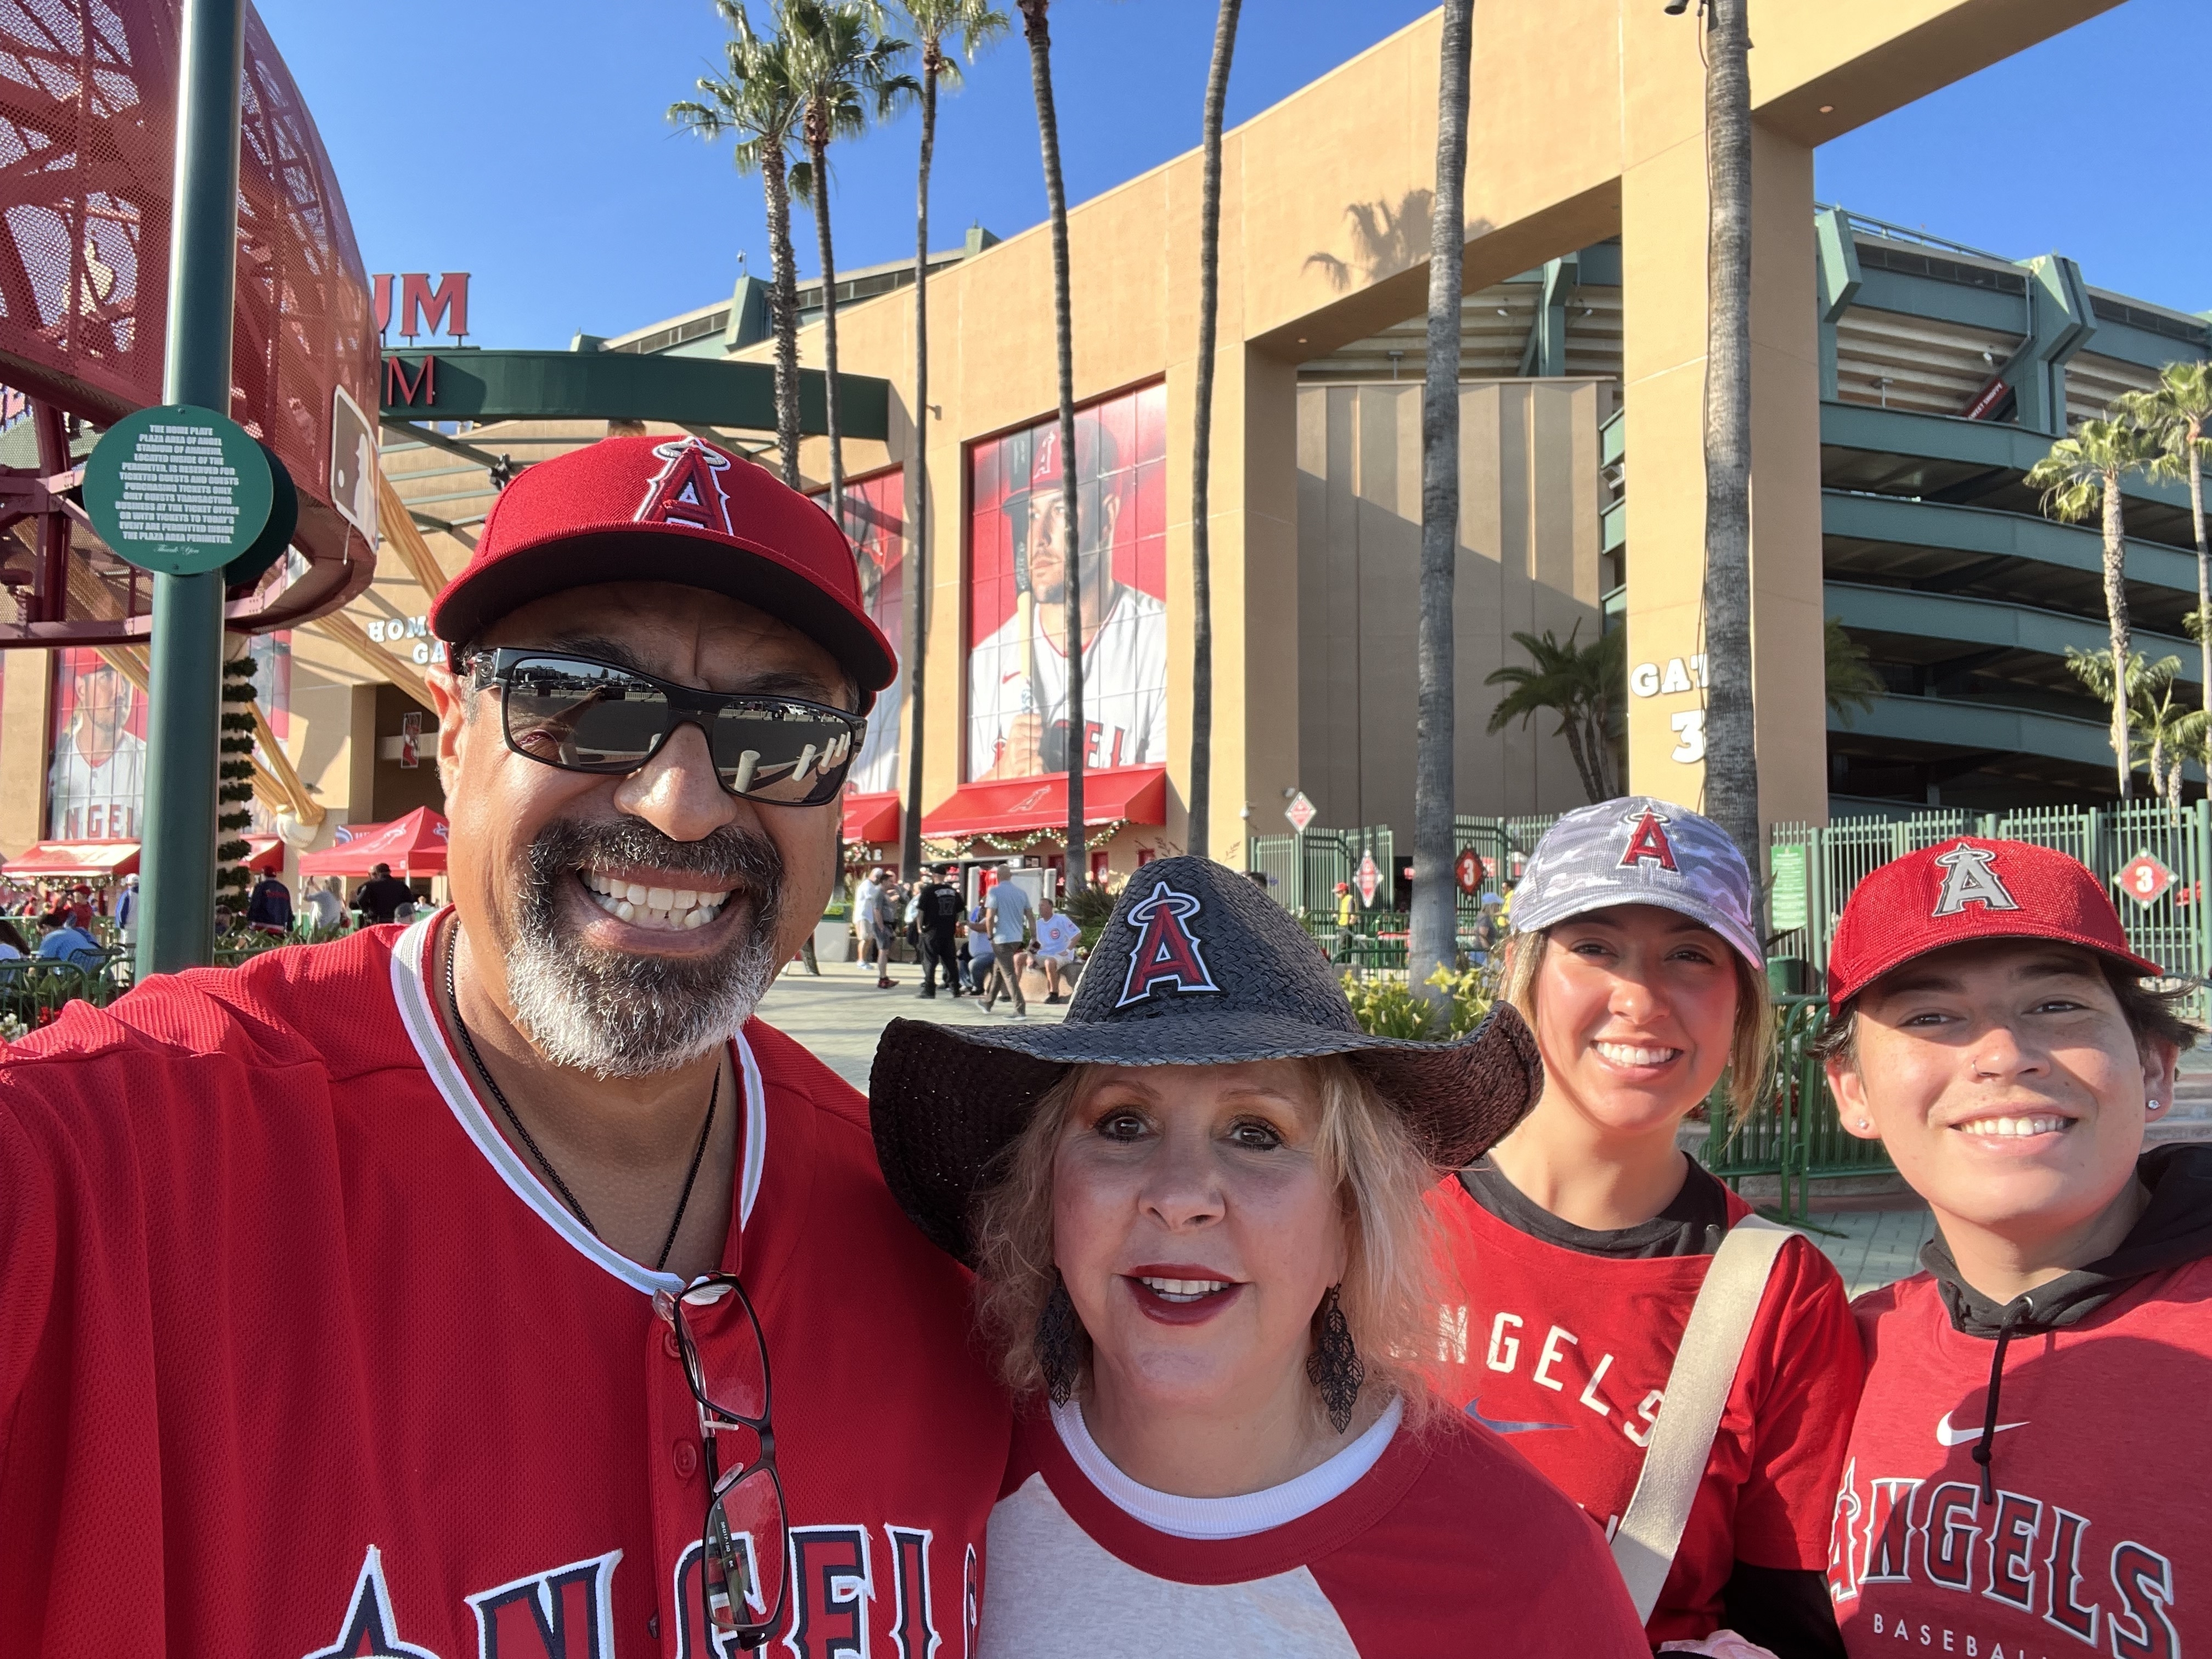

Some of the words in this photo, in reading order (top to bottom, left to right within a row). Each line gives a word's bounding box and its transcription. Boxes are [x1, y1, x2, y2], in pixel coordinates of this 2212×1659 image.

[387, 354, 433, 406] M
[149, 425, 165, 433] THE
[166, 425, 189, 435] HOME
[190, 426, 213, 436] PLATE
[139, 434, 164, 443] PLAZA
[165, 435, 185, 444] AREA
[187, 436, 197, 445] OF
[198, 437, 222, 446] ANGEL
[136, 443, 173, 453] STADIUM
[174, 445, 184, 453] OF
[134, 453, 169, 462] LOCATED
[170, 455, 196, 464] INSIDE
[209, 457, 224, 465] THE
[168, 465, 178, 473] IS
[178, 465, 218, 475] RESERVED
[220, 467, 235, 476] FOR
[119, 472, 157, 481] TICKETED
[159, 473, 189, 483] GUESTS
[190, 475, 207, 484] AND
[208, 476, 239, 486] GUESTS
[125, 482, 177, 492] PURCHASING
[178, 484, 211, 494] TICKETS
[633, 436, 735, 537] A
[123, 492, 143, 500] ONLY
[144, 493, 176, 502] GUESTS
[176, 494, 232, 505] TRANSACTING
[115, 501, 155, 510] BUSINESS
[156, 503, 167, 511] AT
[167, 504, 183, 512] THE
[184, 505, 212, 514] TICKET
[213, 506, 240, 515] OFFICE
[119, 511, 132, 520] OR
[132, 512, 155, 521] WITH
[156, 513, 189, 522] TICKETS
[202, 515, 235, 524] TODAY'S
[119, 521, 144, 530] EVENT
[145, 522, 161, 531] ARE
[161, 523, 207, 533] PERMITTED
[207, 525, 234, 534] INSIDE
[122, 531, 138, 540] THE
[139, 532, 164, 541] PLAZA
[165, 533, 185, 541] AREA
[154, 544, 179, 553] Thank
[180, 545, 200, 555] You
[368, 615, 433, 643] HOM
[1671, 709, 1706, 764] 3
[1616, 805, 1679, 873] A
[1463, 859, 1474, 887] 3
[1932, 842, 2021, 918] A
[2135, 865, 2154, 893] 3
[1115, 881, 1221, 1008] A
[1827, 1456, 2181, 1659] ANGELS
